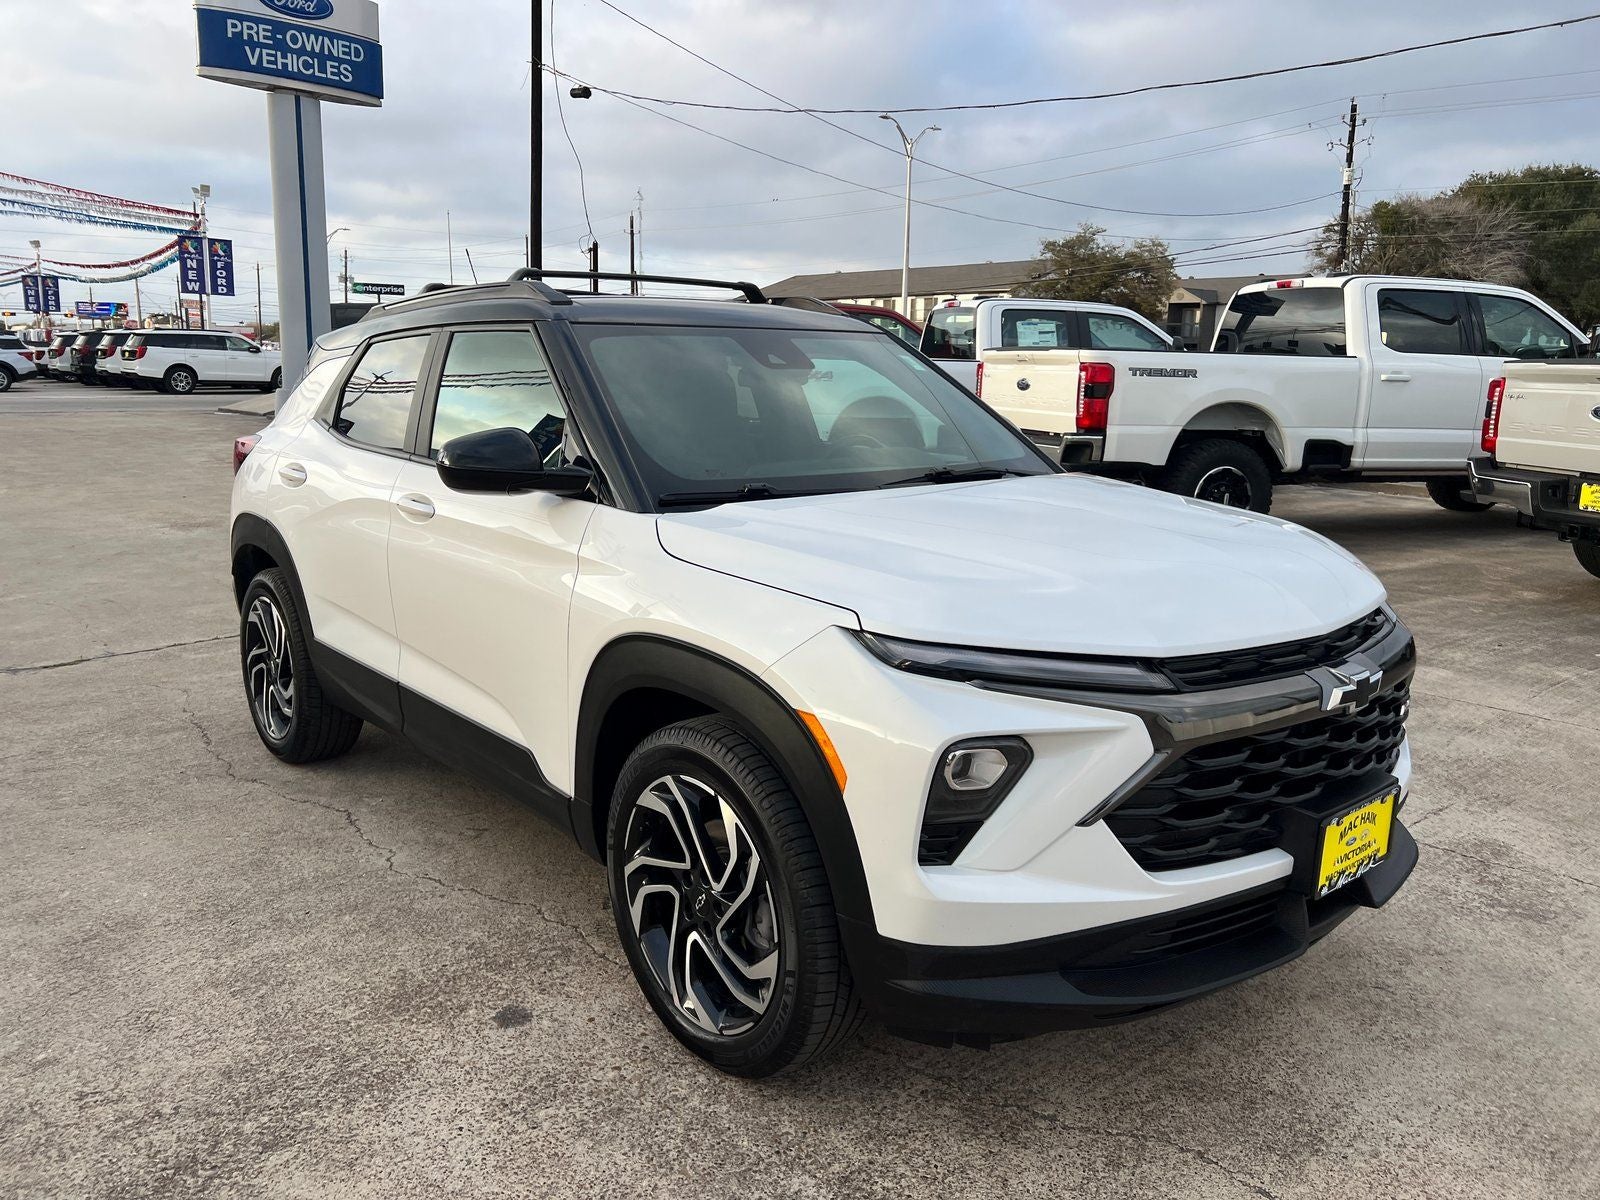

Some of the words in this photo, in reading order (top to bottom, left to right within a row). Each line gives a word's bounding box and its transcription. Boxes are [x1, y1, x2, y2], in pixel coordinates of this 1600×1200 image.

[244, 45, 353, 83] VEHICLES
[186, 258, 200, 292] NEW
[216, 261, 227, 294] FORD
[355, 284, 404, 293] enterprise
[27, 289, 37, 310] NEW
[1128, 366, 1198, 379] TREMOR
[1338, 815, 1360, 844] MAC
